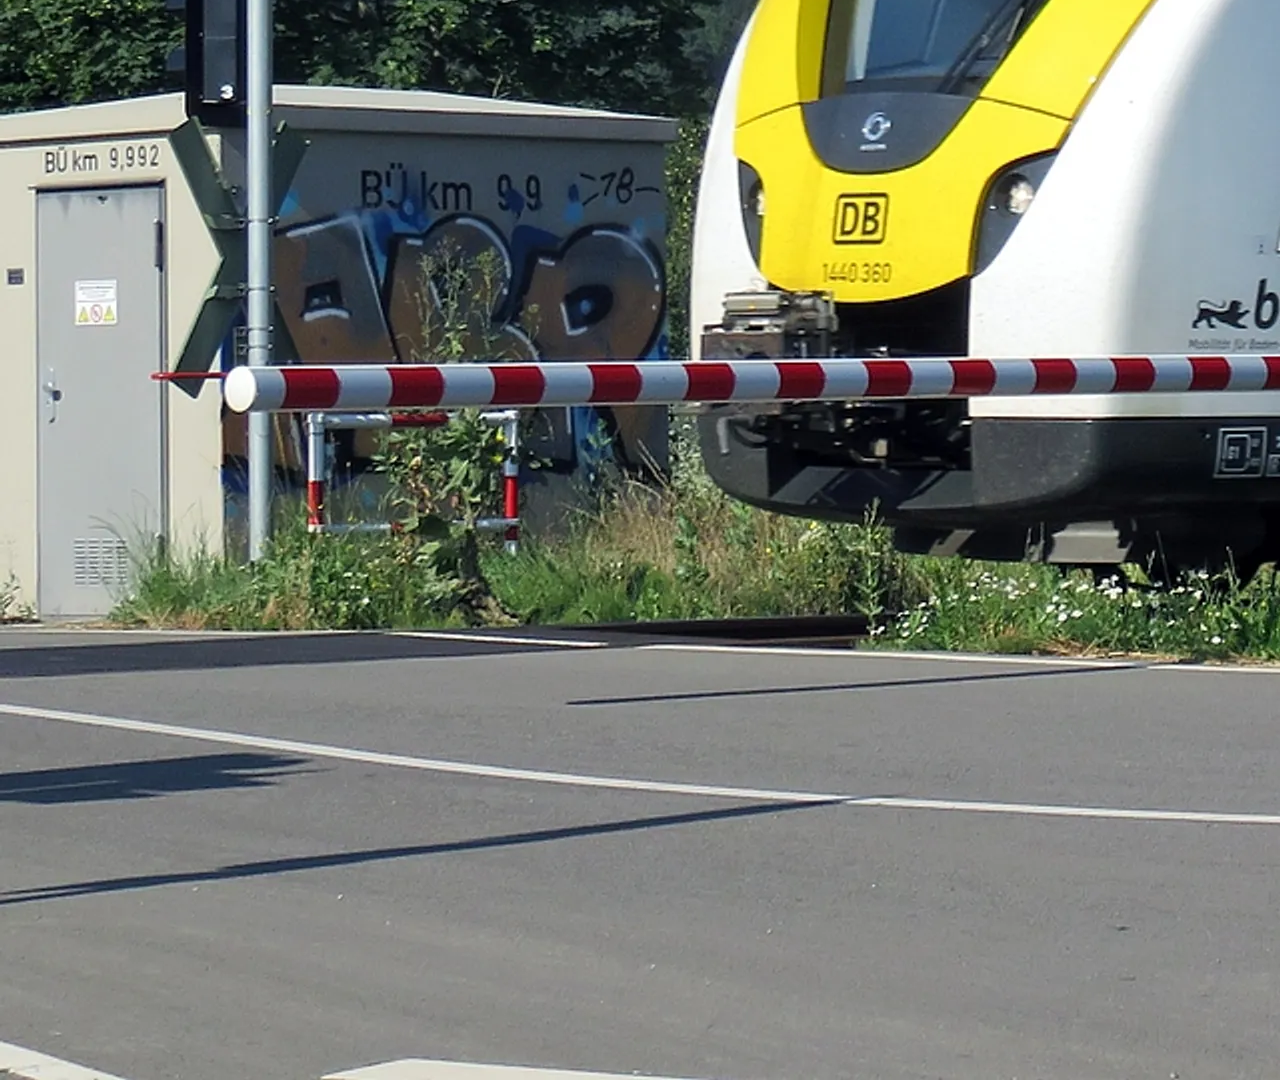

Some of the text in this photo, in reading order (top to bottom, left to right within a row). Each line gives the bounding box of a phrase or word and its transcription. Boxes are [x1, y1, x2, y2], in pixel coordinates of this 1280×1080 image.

[220, 83, 234, 99] 3
[45, 144, 160, 173] BÜ km 9,992
[420, 170, 473, 211] km
[838, 200, 882, 238] DB
[822, 261, 892, 284] 1440 360
